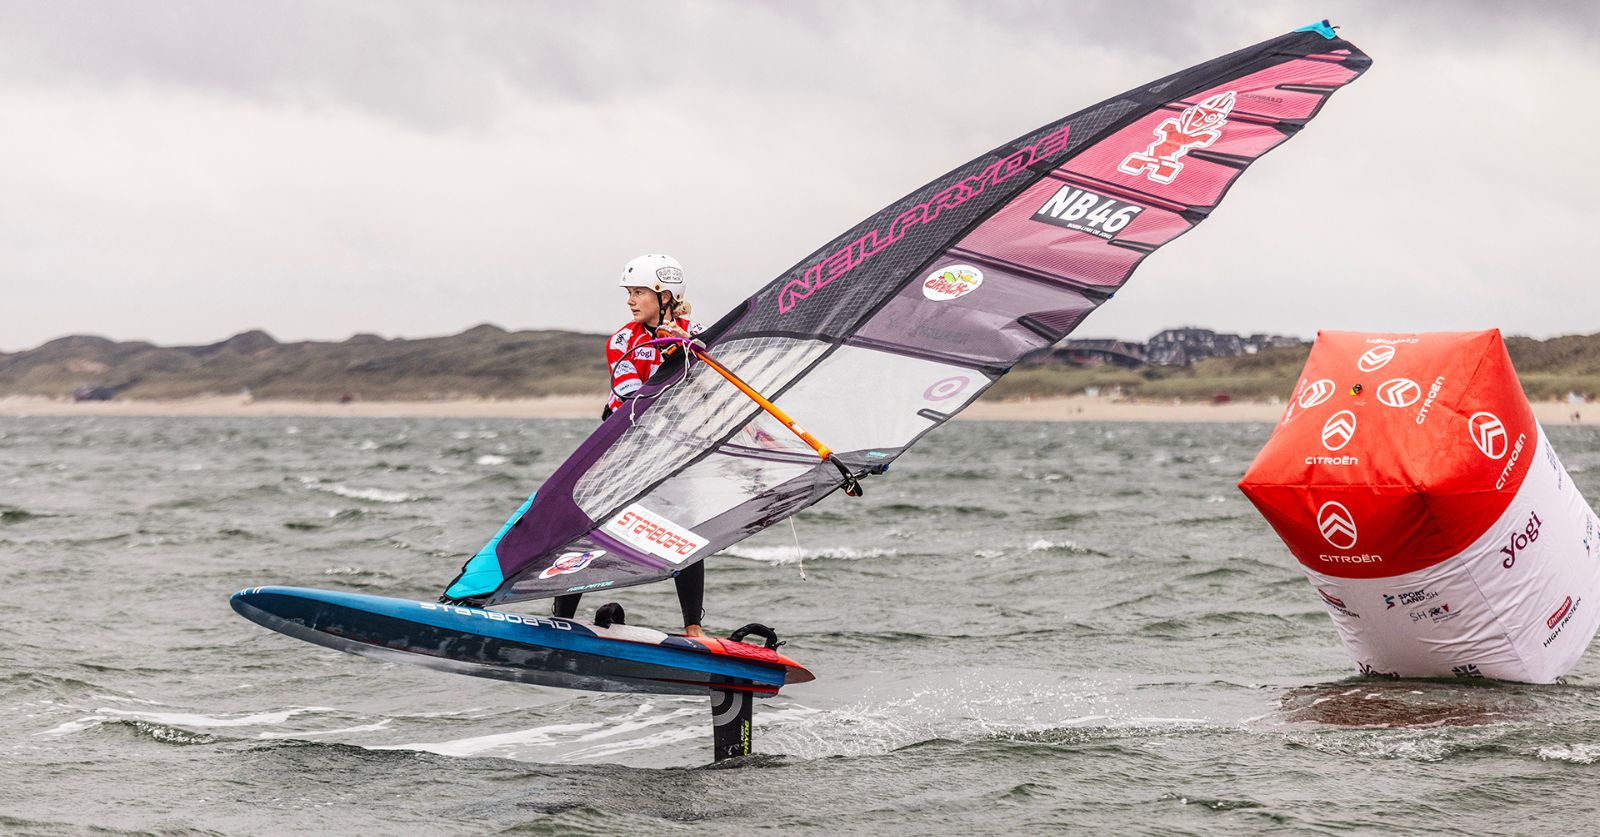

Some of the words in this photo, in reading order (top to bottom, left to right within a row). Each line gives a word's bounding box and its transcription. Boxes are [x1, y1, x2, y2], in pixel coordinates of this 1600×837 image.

[778, 125, 1071, 314] NEILPRYDE
[1037, 185, 1142, 232] NB46
[636, 349, 652, 359] yogi
[1500, 511, 1543, 569] yogi
[1398, 589, 1425, 600] SPORT
[1409, 611, 1427, 623] SH
[1543, 628, 1561, 648] HIGH
[1561, 597, 1582, 630] PROTEIN
